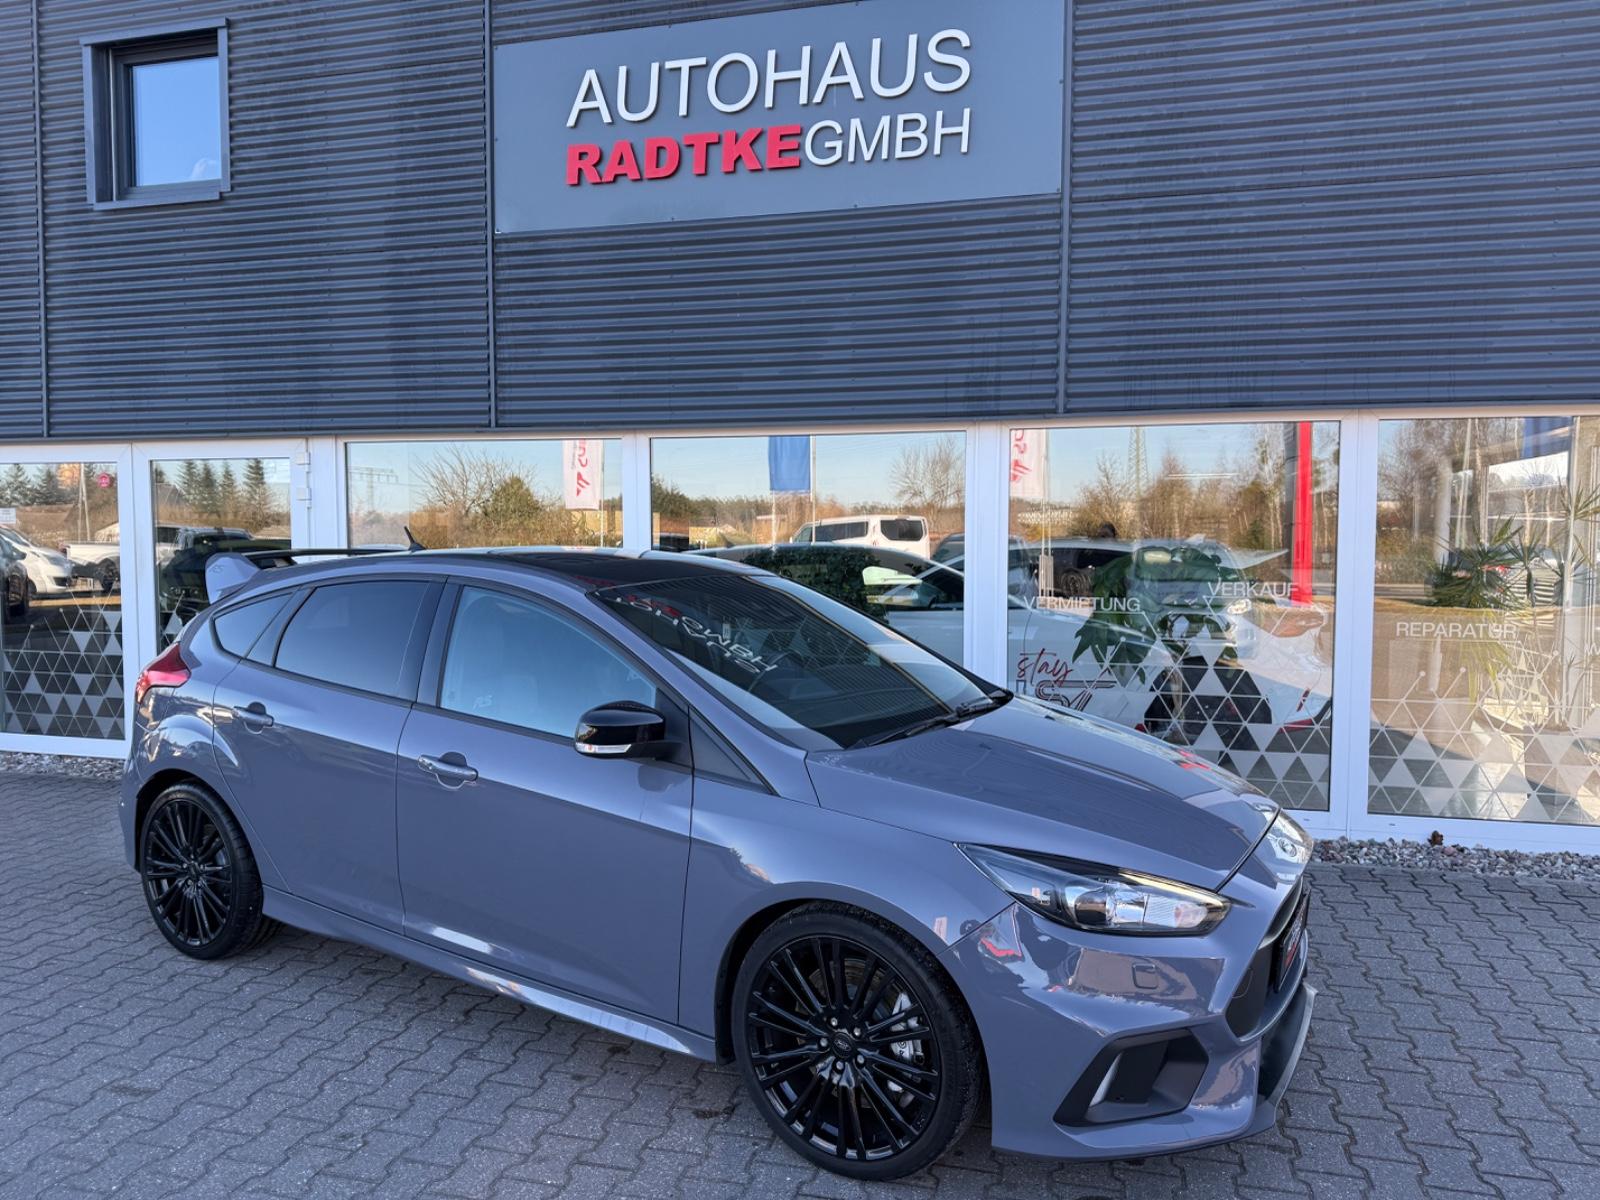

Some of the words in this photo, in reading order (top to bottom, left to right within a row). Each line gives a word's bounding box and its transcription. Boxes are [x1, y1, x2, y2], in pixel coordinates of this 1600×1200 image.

[566, 28, 971, 128] AUTOHAUS
[1208, 581, 1299, 597] VERKAUF
[1023, 596, 1141, 612] VERMIETUNG
[1395, 621, 1518, 639] REPARATUR
[1017, 648, 1073, 687] stay
